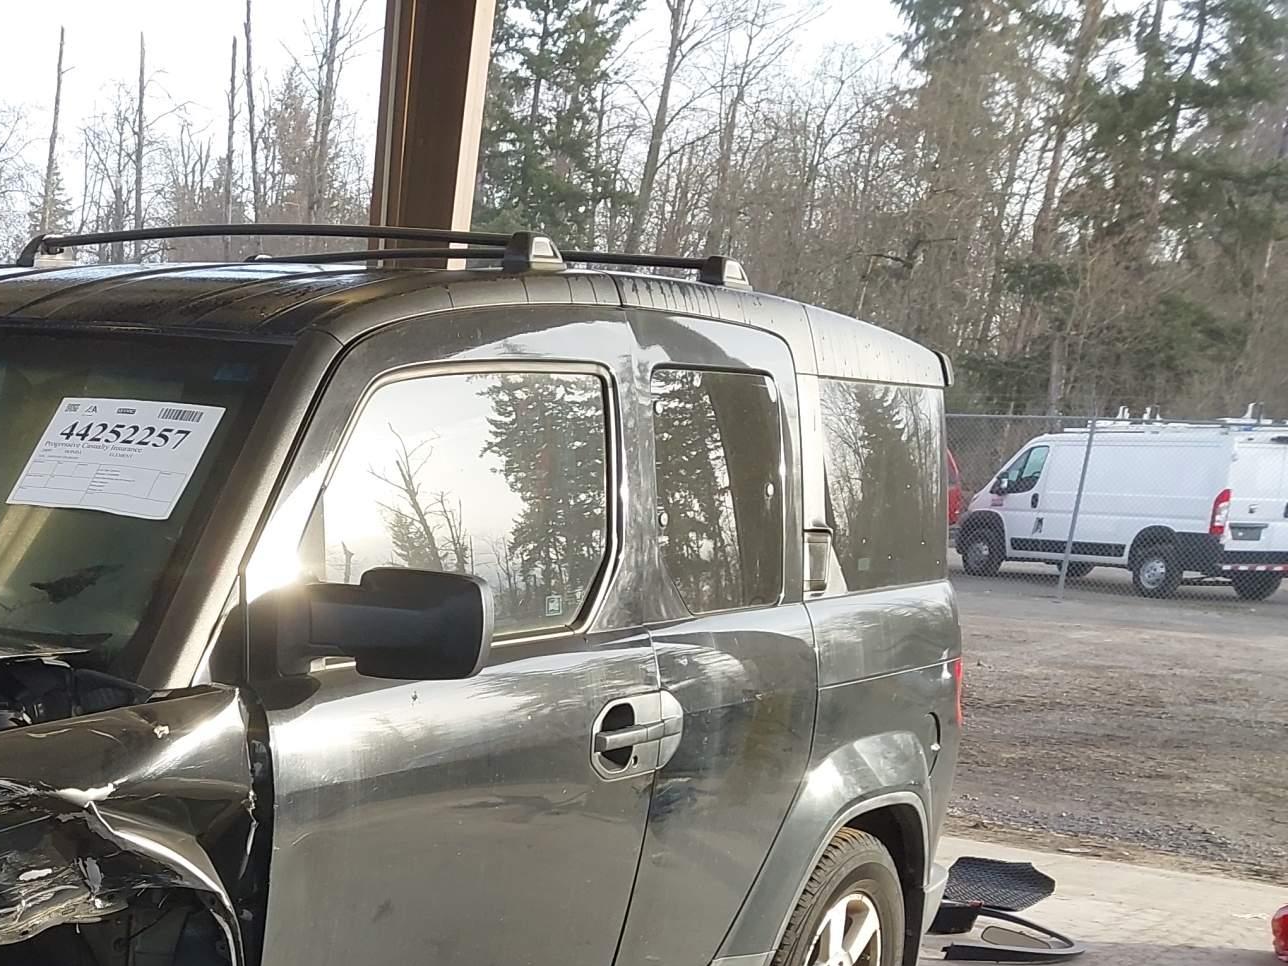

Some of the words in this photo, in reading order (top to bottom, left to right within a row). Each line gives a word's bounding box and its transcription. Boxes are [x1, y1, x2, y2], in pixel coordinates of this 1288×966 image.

[60, 420, 192, 450] 44252257
[44, 440, 81, 449] Progressive
[82, 442, 109, 454] Casualty
[110, 444, 143, 454] Insurance
